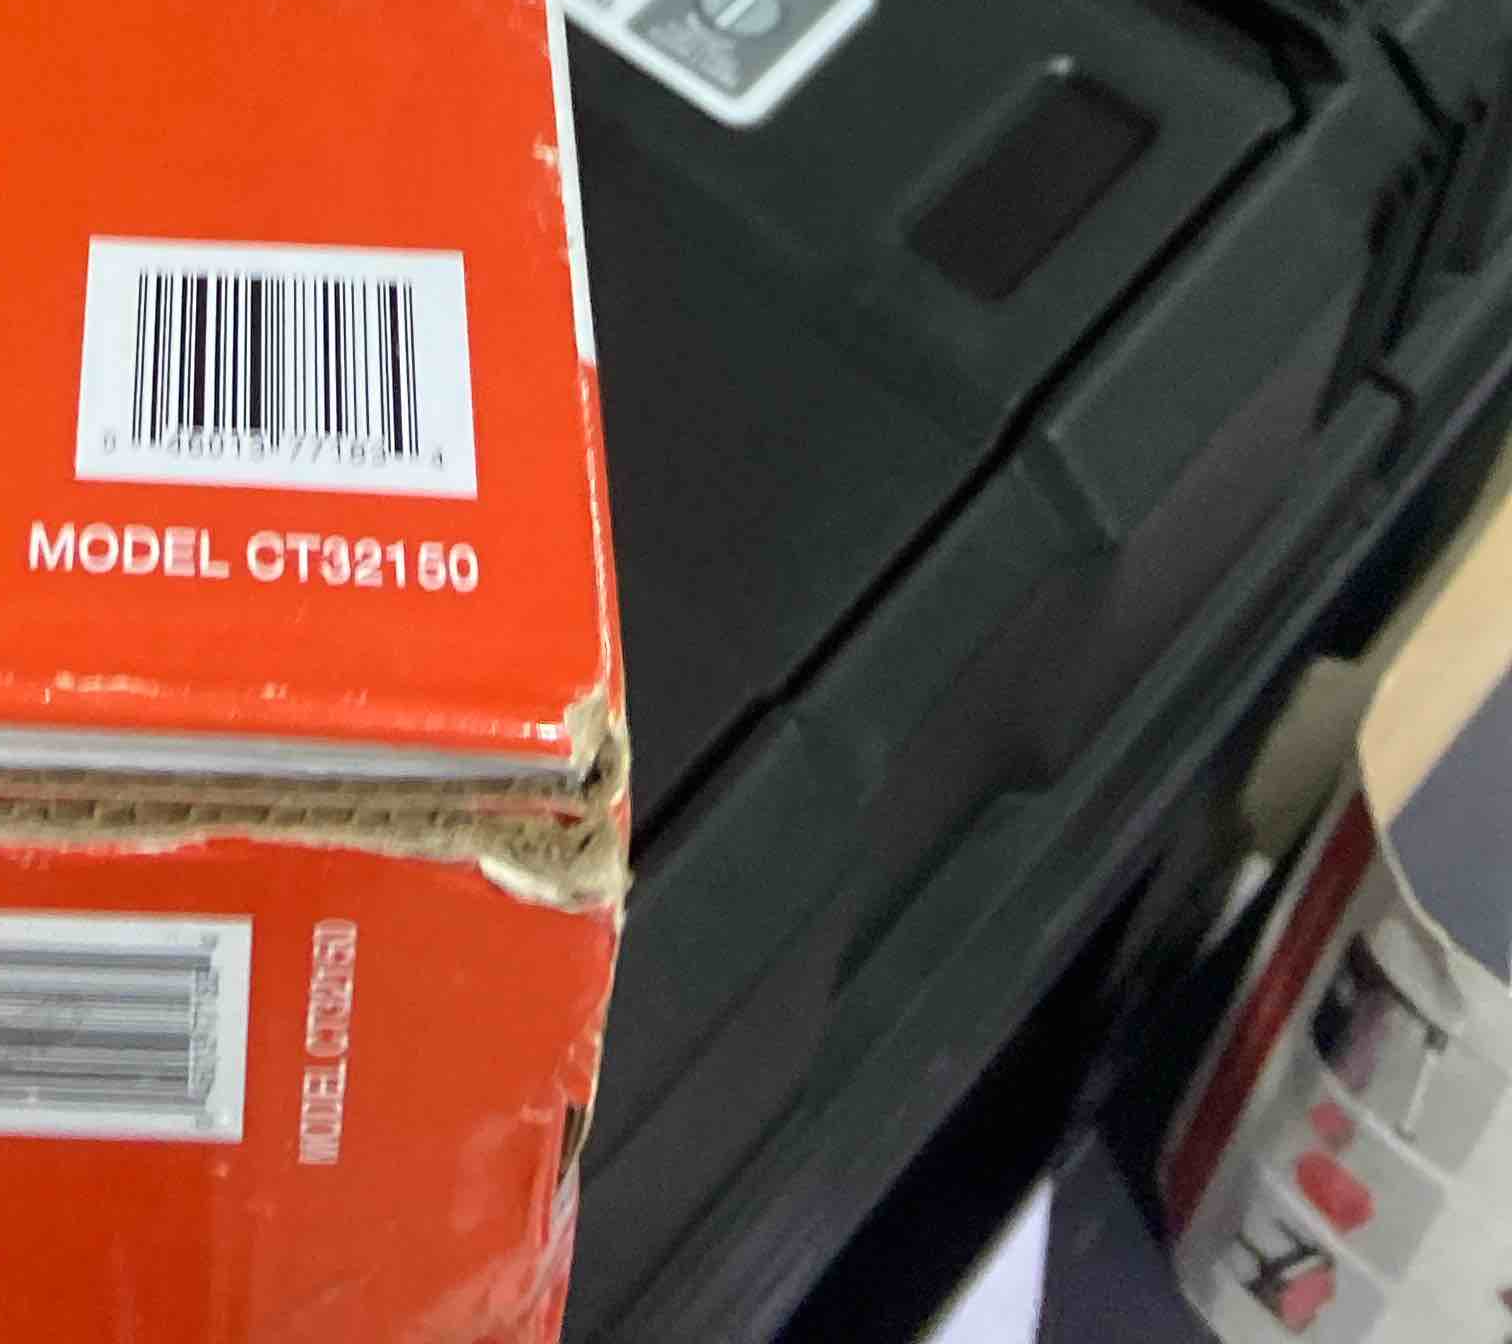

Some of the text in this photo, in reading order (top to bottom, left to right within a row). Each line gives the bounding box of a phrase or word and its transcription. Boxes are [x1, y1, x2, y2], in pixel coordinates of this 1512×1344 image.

[27, 520, 481, 594] MODEL CT32150
[298, 1057, 348, 1165] MODEL
